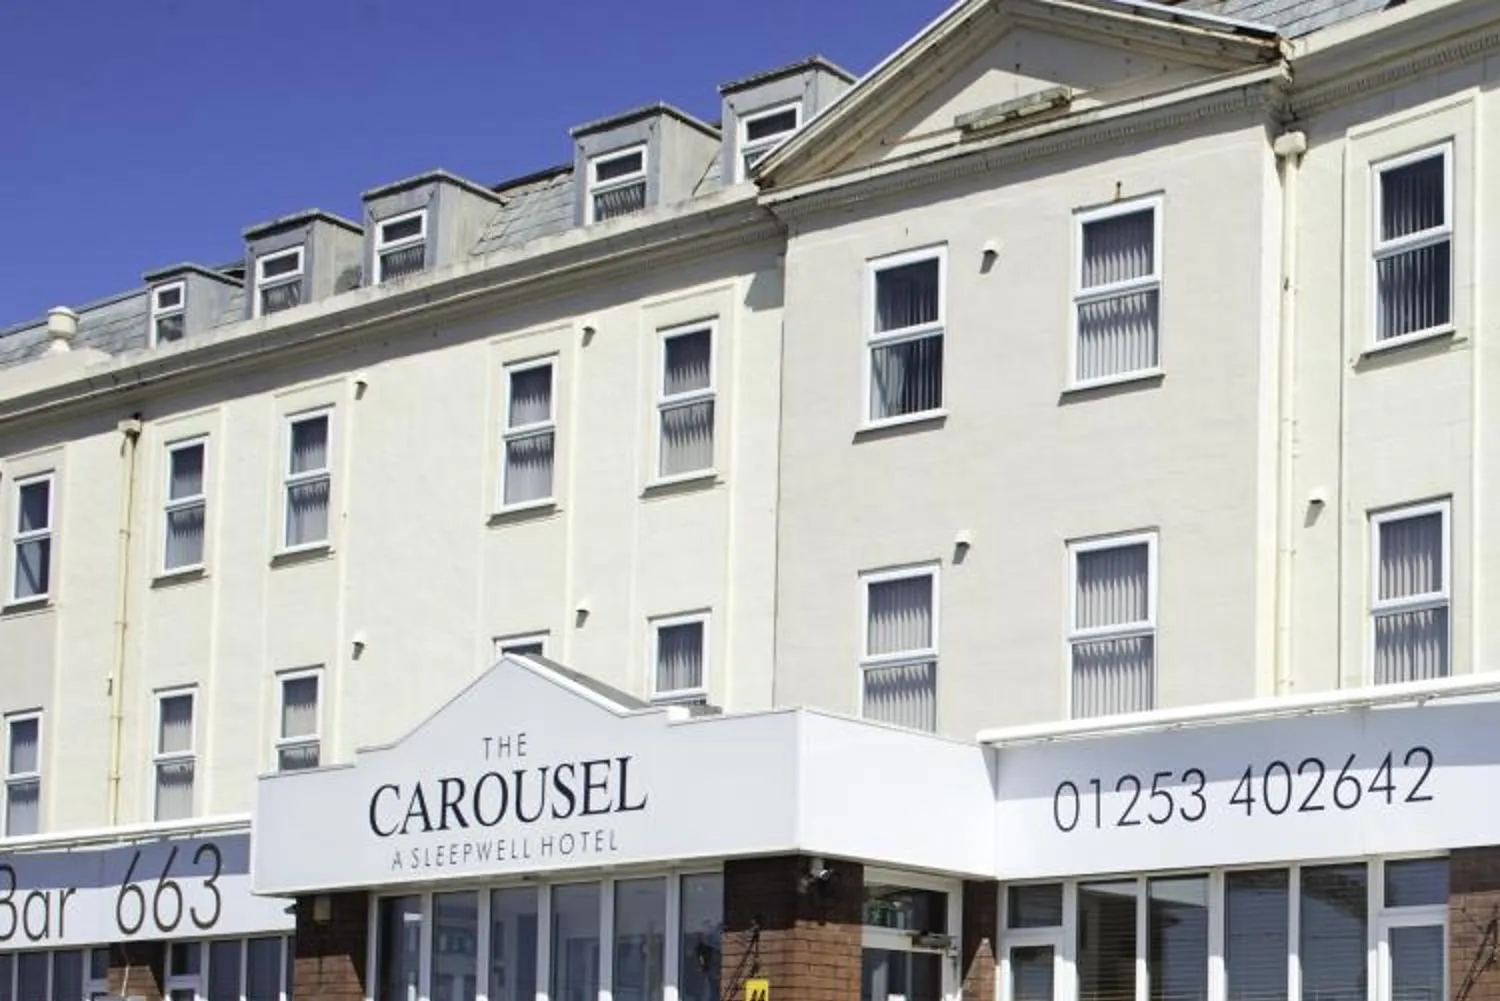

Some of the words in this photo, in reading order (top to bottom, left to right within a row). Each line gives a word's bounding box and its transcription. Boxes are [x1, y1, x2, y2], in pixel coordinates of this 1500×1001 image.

[482, 732, 528, 761] THE
[369, 756, 648, 837] CAROUSEL
[1053, 768, 1207, 832] 01253
[1229, 745, 1434, 817] 402642
[116, 842, 222, 936] 663
[391, 851, 403, 871] A
[411, 838, 531, 869] SLEEPWELL
[541, 829, 618, 857] HOTEL
